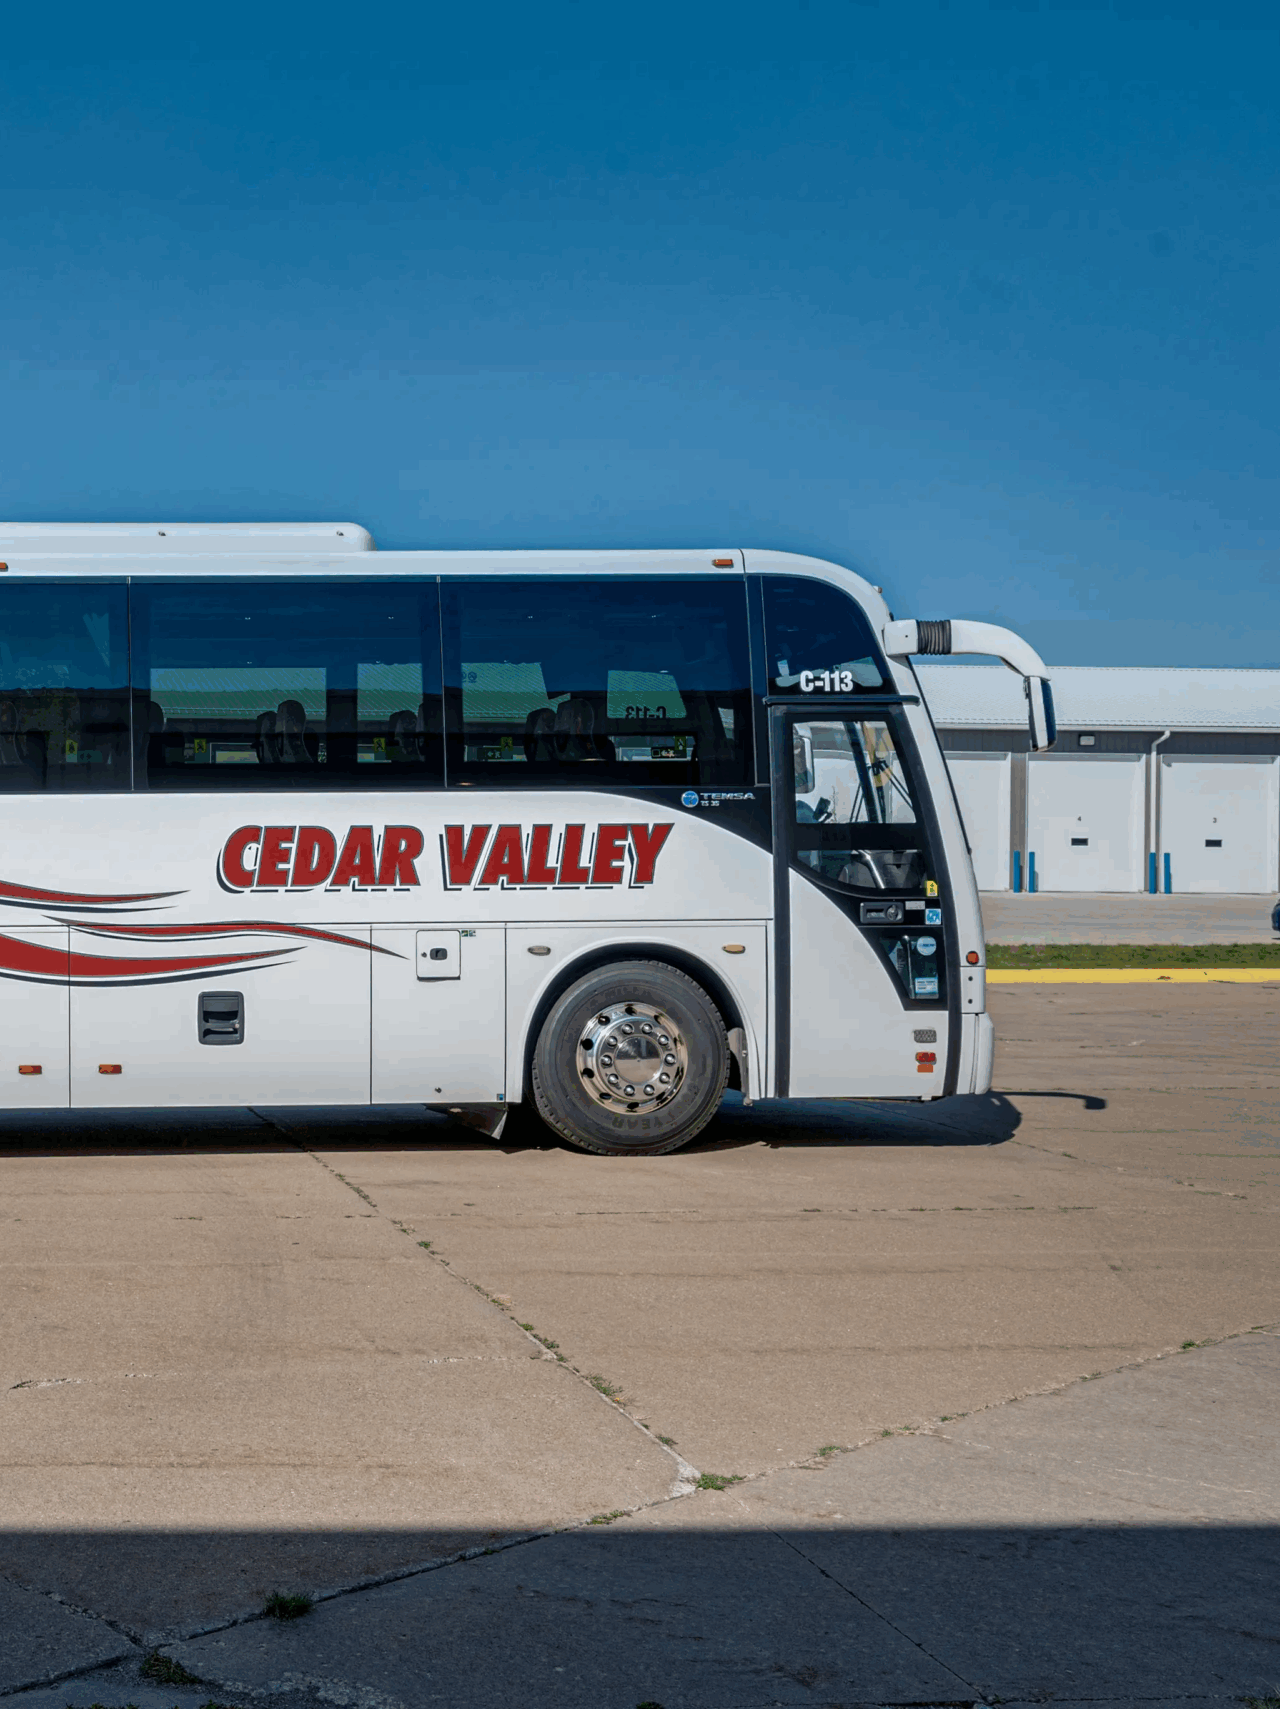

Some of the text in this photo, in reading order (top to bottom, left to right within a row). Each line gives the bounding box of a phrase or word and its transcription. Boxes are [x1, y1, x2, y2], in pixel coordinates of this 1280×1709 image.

[800, 670, 854, 692] C-113
[700, 792, 756, 800] TEMSA
[216, 823, 675, 893] CEDAR VALLEY
